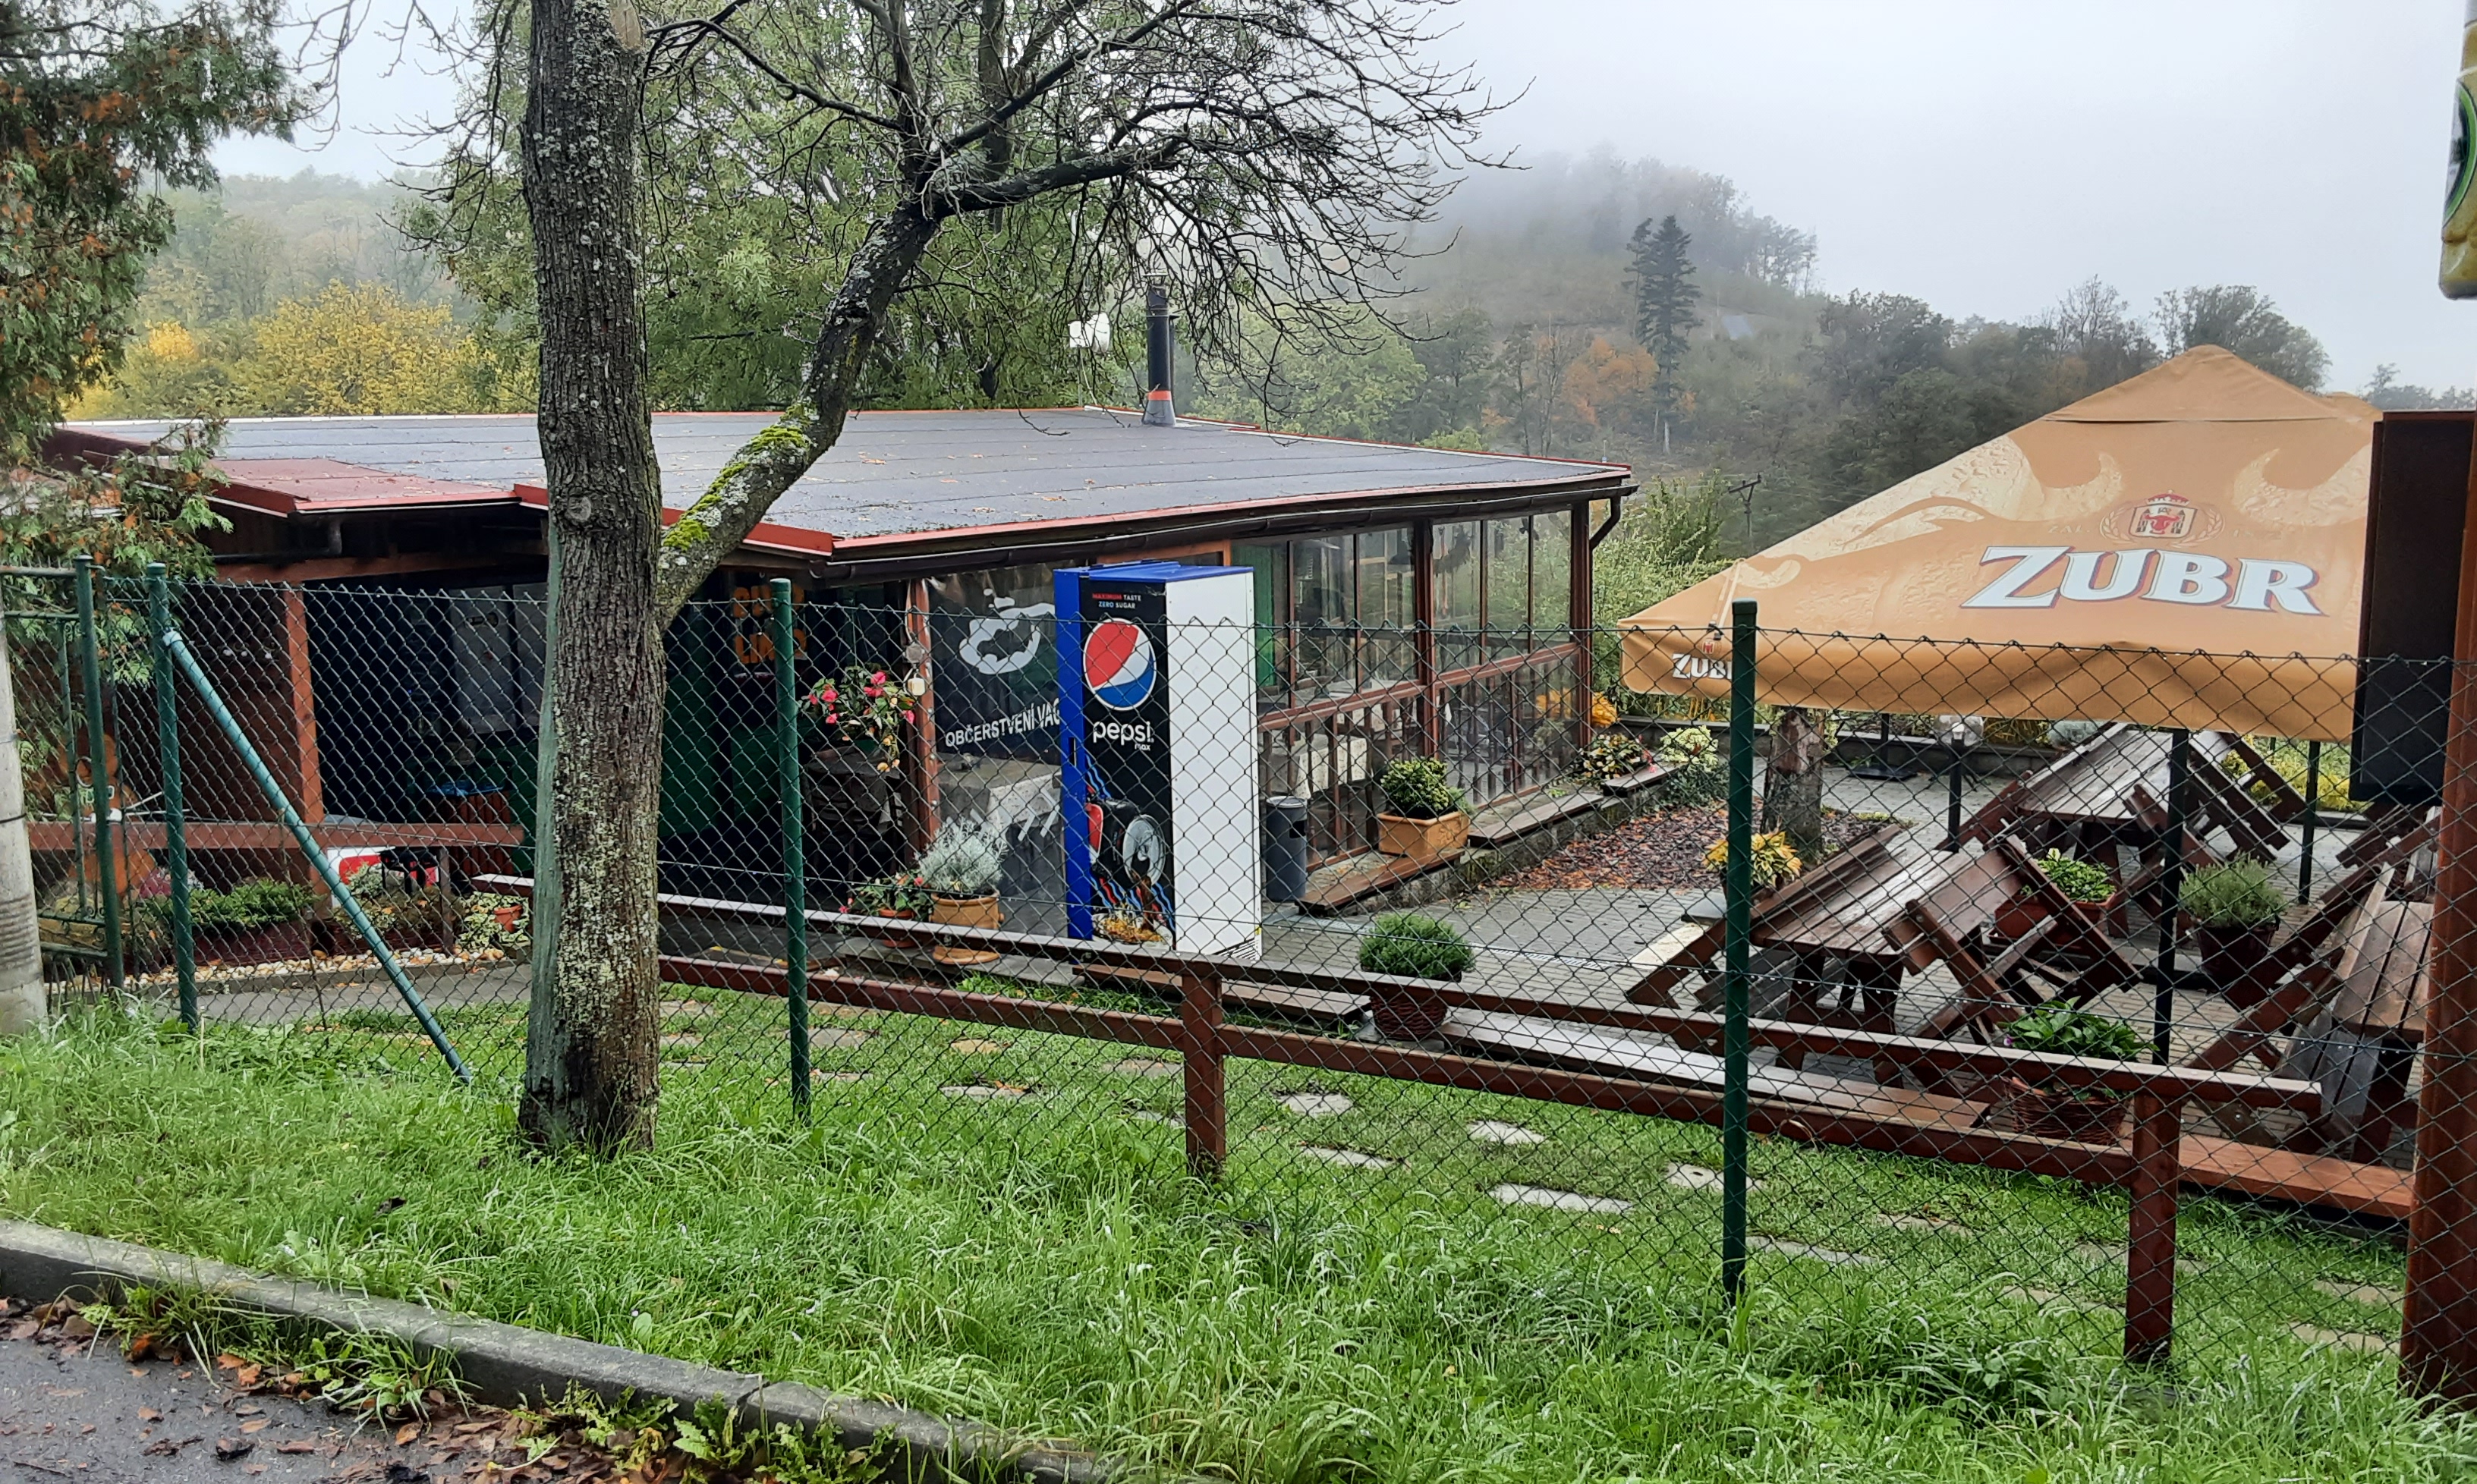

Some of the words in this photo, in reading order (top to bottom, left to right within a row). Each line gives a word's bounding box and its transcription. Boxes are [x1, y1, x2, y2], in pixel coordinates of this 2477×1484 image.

[1960, 545, 2327, 616] ZUBR
[945, 703, 1036, 747] OBČERSTVENÍ
[1093, 721, 1151, 746] pepsi
[1135, 743, 1150, 751] max
